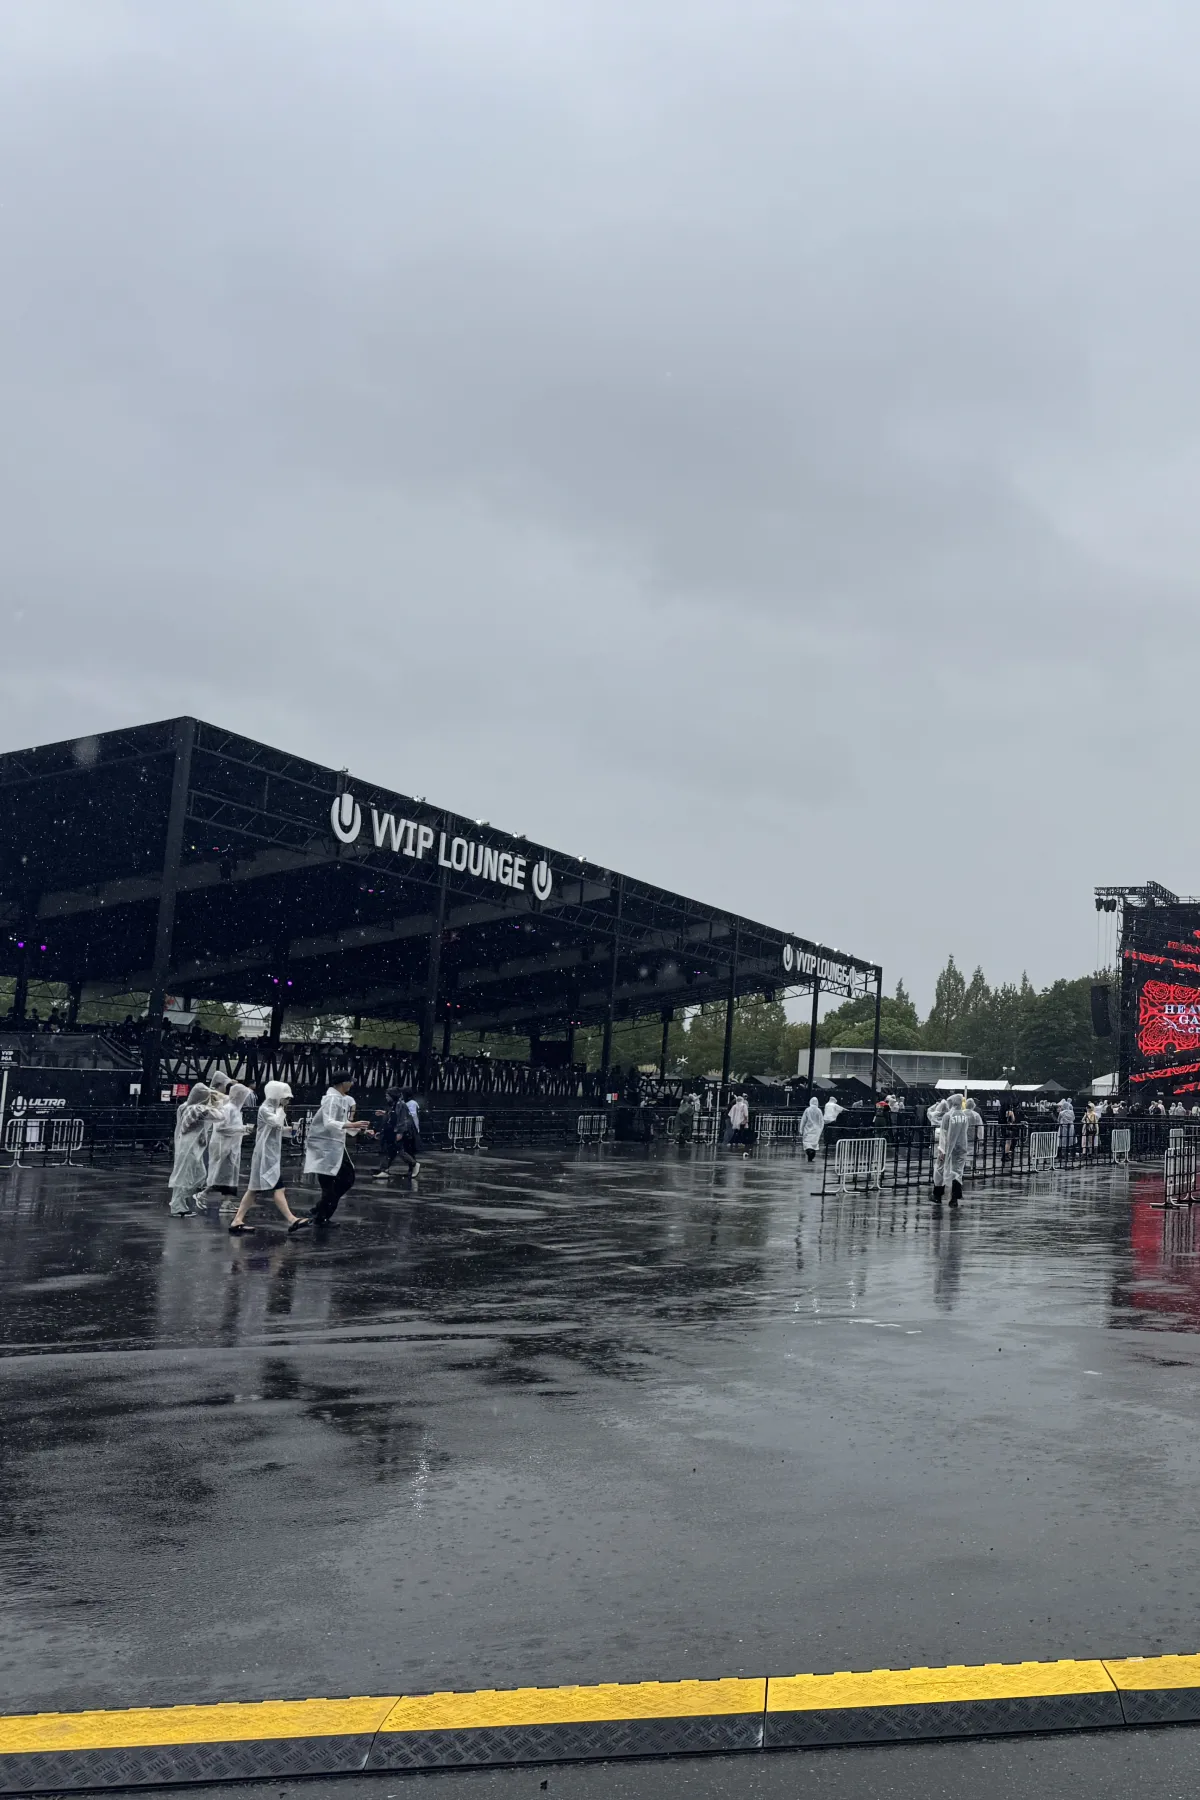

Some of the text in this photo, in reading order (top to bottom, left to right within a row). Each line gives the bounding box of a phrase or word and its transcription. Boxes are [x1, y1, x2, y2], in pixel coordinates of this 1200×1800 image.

[371, 808, 526, 890] VVIP LOUNGE
[796, 950, 848, 983] VVIP LOUNGE
[28, 1098, 66, 1106] ULTRA
